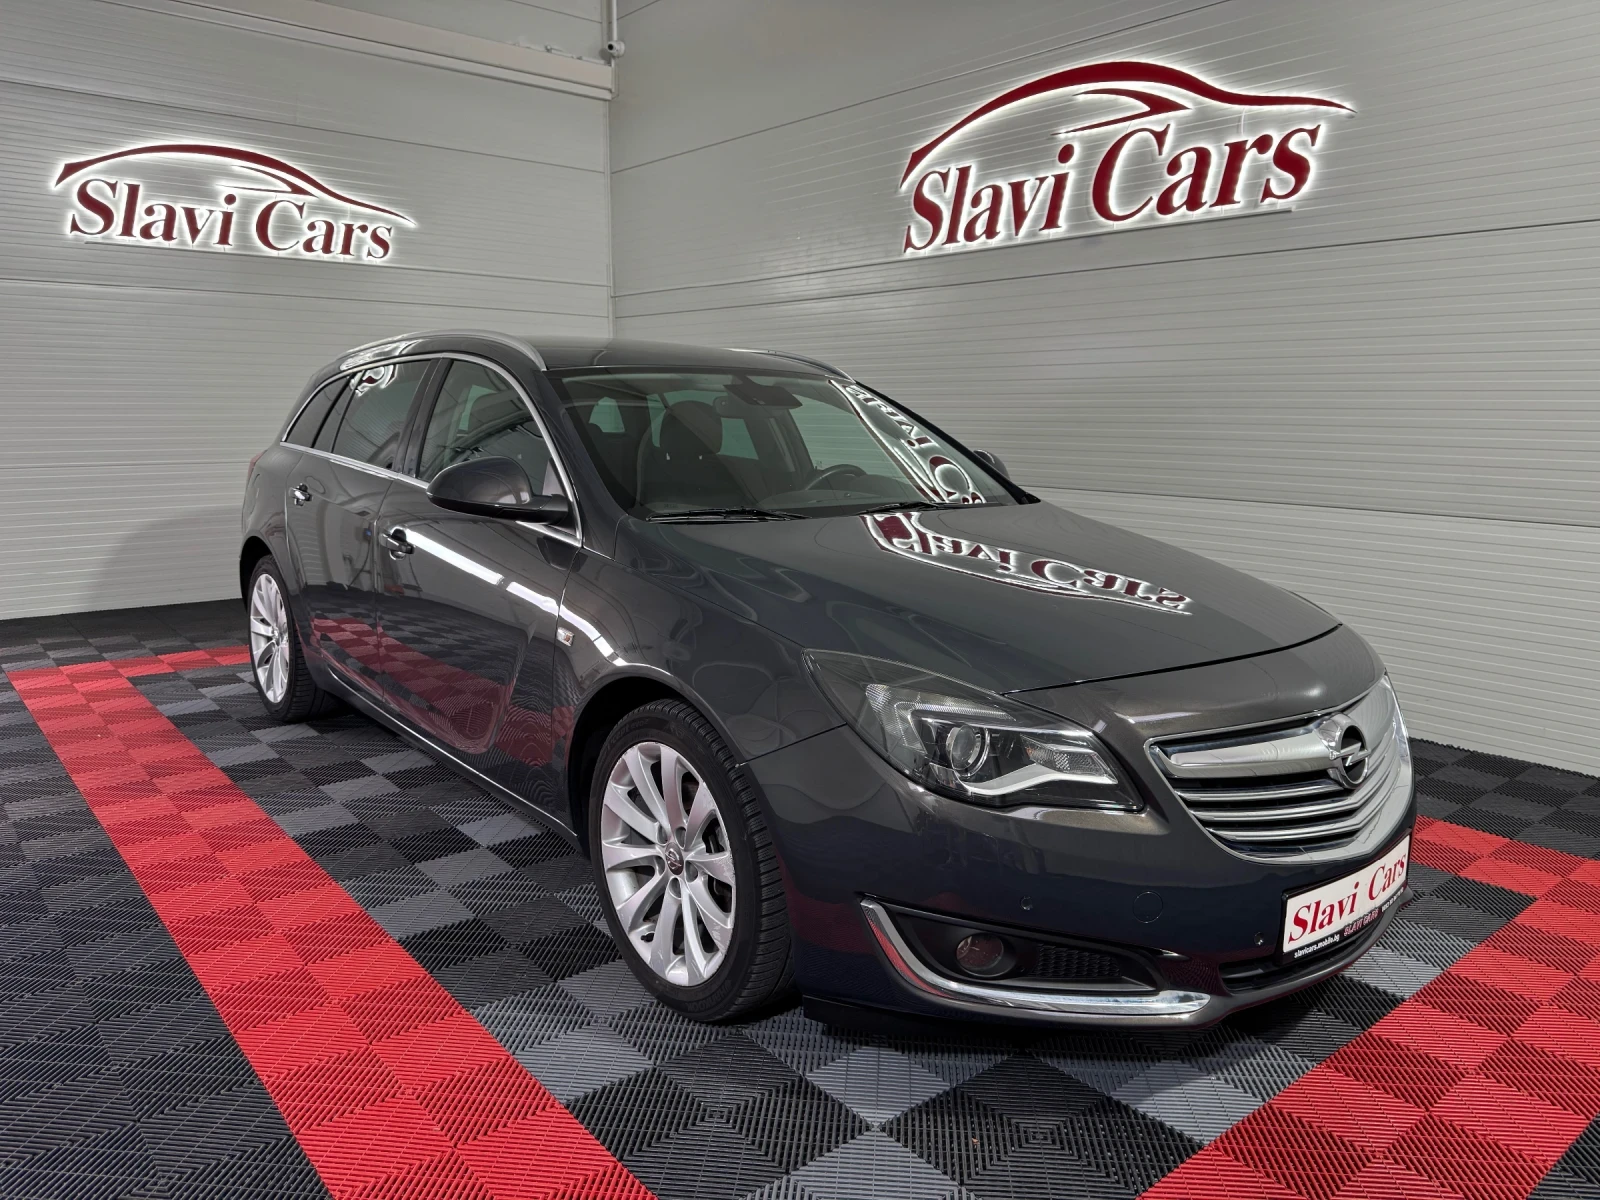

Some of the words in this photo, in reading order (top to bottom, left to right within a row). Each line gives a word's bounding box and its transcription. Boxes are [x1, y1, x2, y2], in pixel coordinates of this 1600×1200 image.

[69, 179, 237, 246] Slavi
[255, 200, 393, 259] Cars
[903, 143, 1075, 253] Slavi
[1092, 124, 1321, 222] Cars
[1288, 881, 1360, 944] Slavi
[1368, 854, 1406, 900] Cars
